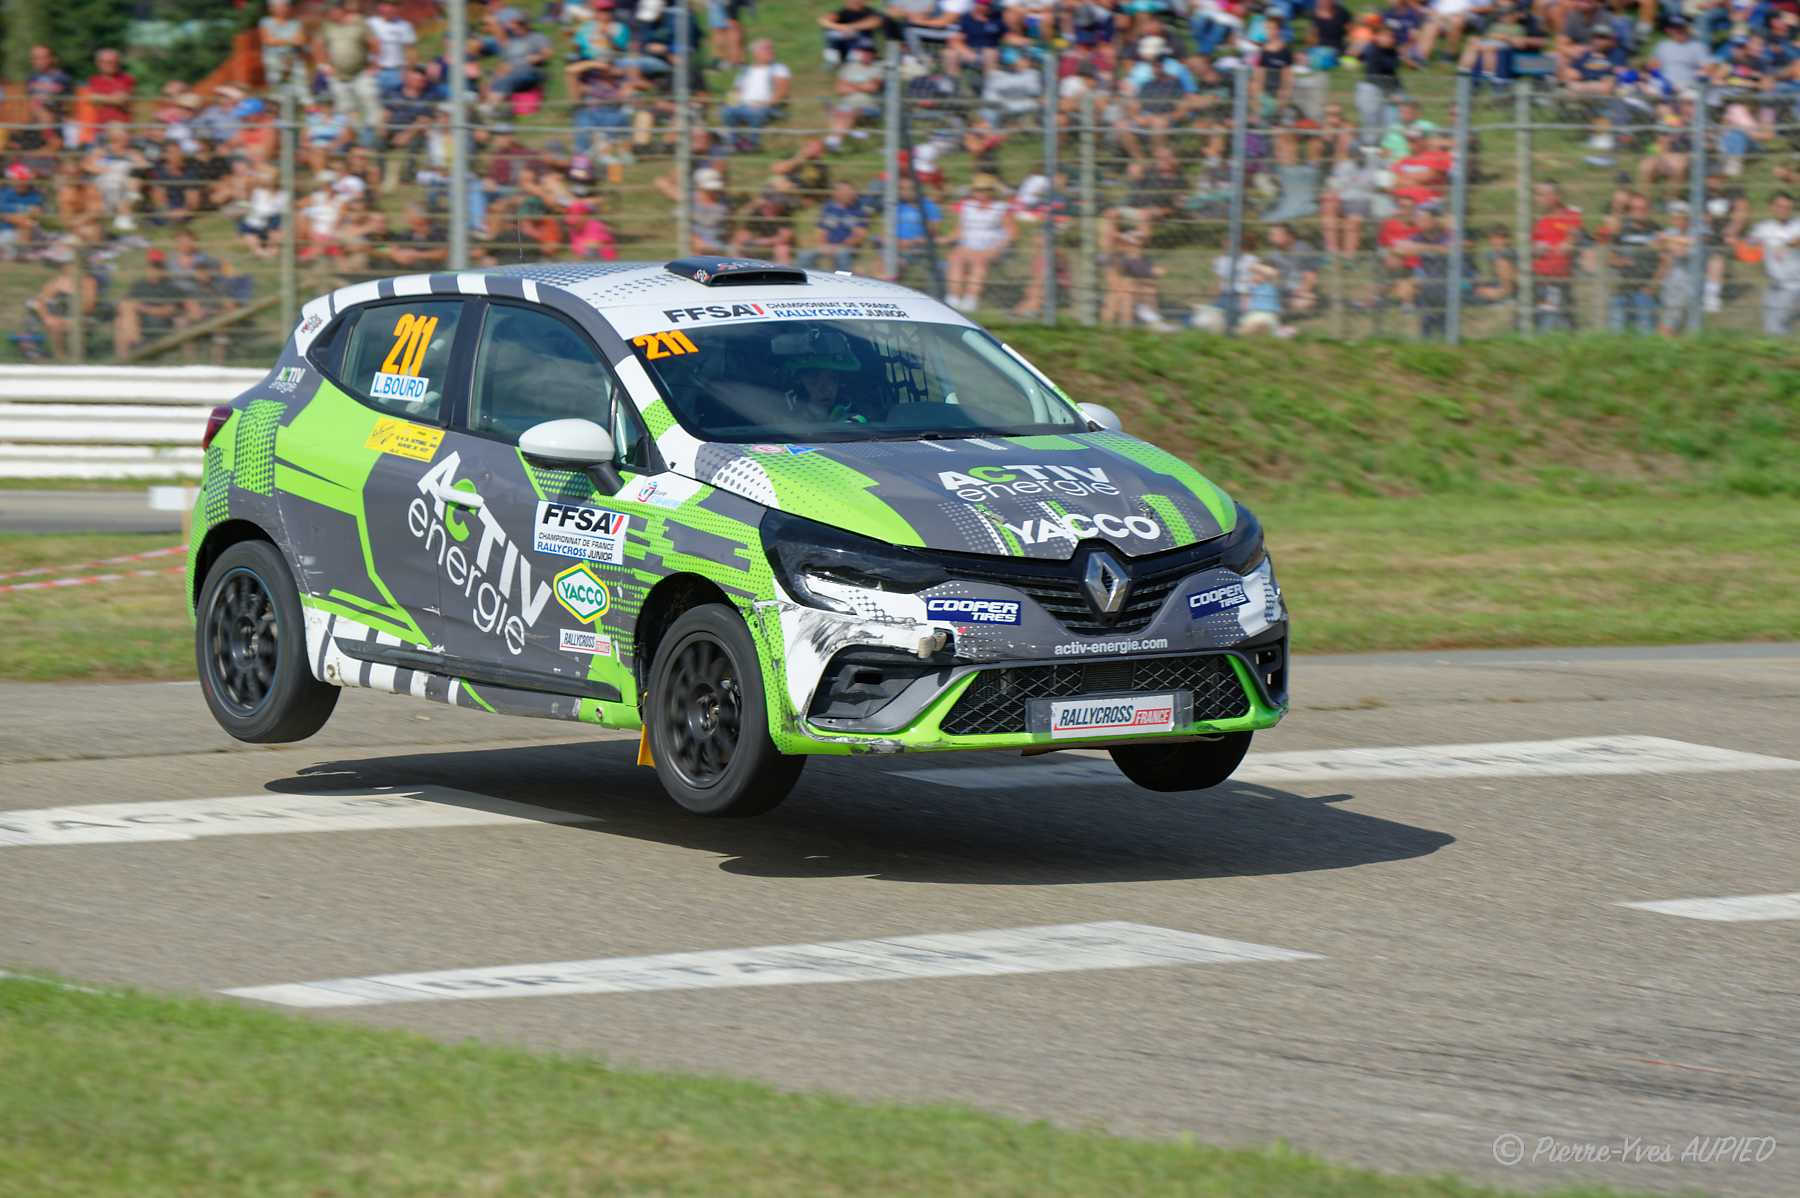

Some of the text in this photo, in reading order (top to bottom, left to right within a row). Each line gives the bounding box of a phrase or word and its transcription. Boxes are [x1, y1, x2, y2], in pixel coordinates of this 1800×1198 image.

[663, 304, 757, 322] FFSA
[766, 301, 841, 309] CHAMPIONNAT
[774, 308, 910, 318] RALLYCROSS JUNIOR
[381, 313, 438, 377] 211
[633, 330, 699, 360] 211
[373, 376, 424, 398] L.BOURD
[938, 464, 1110, 490] ACTIV
[956, 479, 1120, 501] energie
[542, 503, 611, 534] FFSA
[1003, 512, 1161, 544] YACCO
[417, 451, 552, 627] ACTIV
[538, 532, 614, 551] CHAMPIONNAT DE FRANCE
[537, 542, 613, 561] RALLYCROSS JUNIOR
[408, 498, 525, 655] energie
[561, 581, 603, 606] YACCO
[1189, 583, 1244, 608] COOPER
[1219, 594, 1247, 608] TIRES
[928, 600, 1019, 614] COOPER
[971, 612, 1017, 622] TIRES
[563, 632, 596, 648] RALLYCROSS
[1055, 637, 1168, 655] activ-energie.com
[1060, 705, 1169, 726] RALLYCROSS FRANCE
